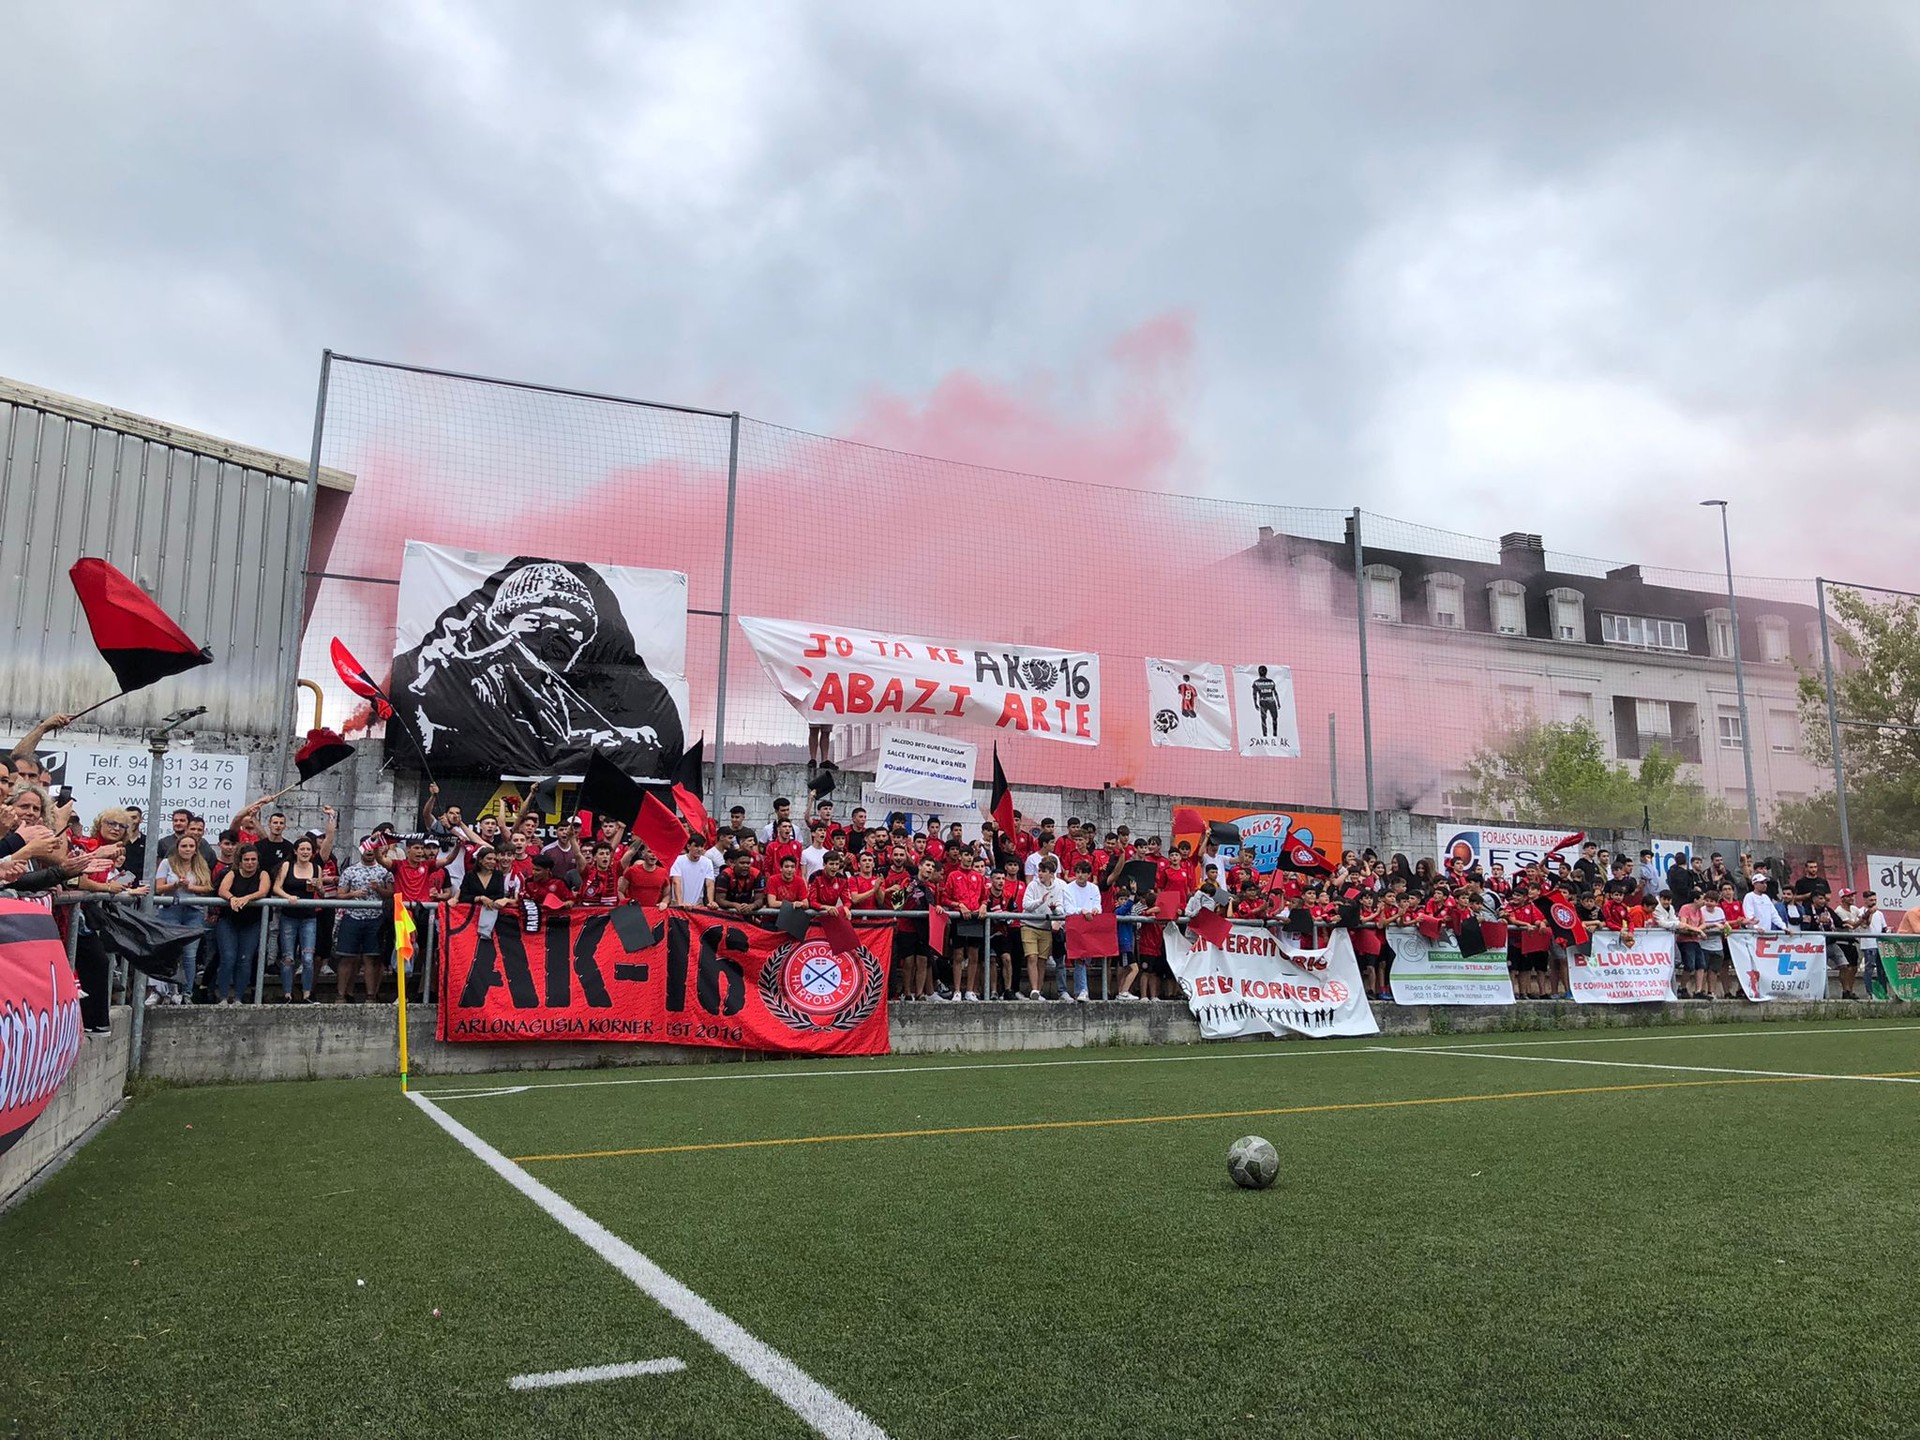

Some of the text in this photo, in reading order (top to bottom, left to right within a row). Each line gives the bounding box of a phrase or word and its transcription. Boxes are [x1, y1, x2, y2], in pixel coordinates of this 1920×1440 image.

[803, 633, 964, 665] JO TA KE
[974, 651, 1090, 699] AK 16
[995, 693, 1091, 738] ARTE
[90, 753, 122, 769] Telf.
[128, 756, 148, 769] 94
[190, 759, 208, 772] 34
[215, 760, 234, 773] 75
[887, 749, 905, 758] SALCE
[941, 759, 967, 770] KORNER
[85, 772, 120, 787] Fax.
[127, 774, 147, 787] 94
[188, 777, 208, 790] 32
[214, 778, 233, 791] 76
[1241, 816, 1283, 840] uñoz
[1513, 833, 1538, 845] SANTA
[458, 914, 750, 1017] AK-16
[1604, 968, 1625, 976] 946
[1644, 967, 1660, 975] 310
[792, 975, 836, 1006] HARROBI
[1240, 979, 1325, 1003] KORNER
[589, 1018, 654, 1035] KORNER
[695, 1023, 743, 1042] 2016
